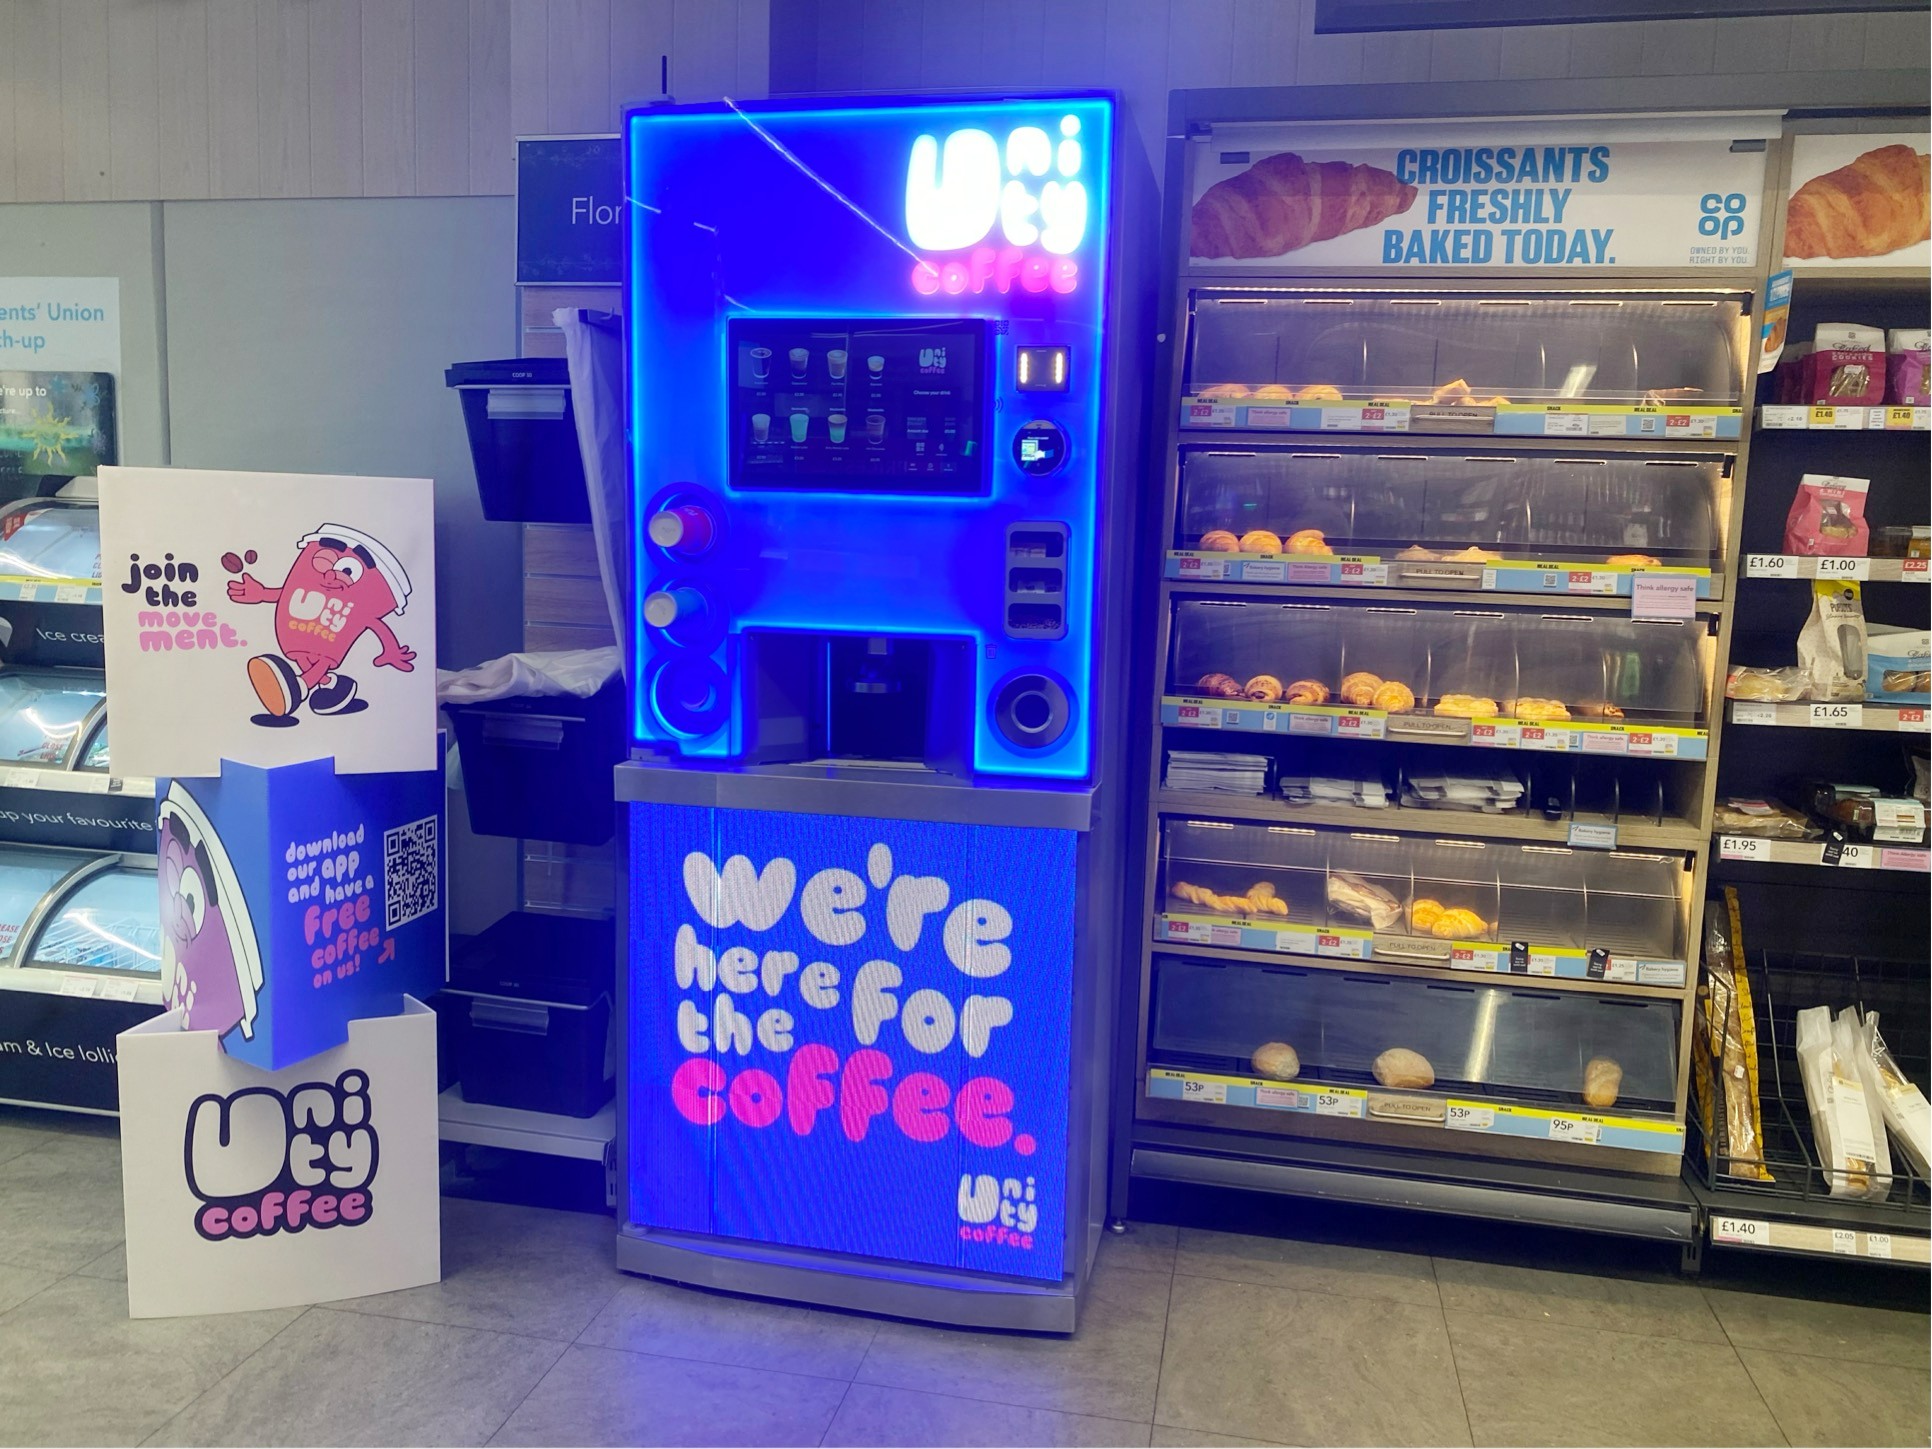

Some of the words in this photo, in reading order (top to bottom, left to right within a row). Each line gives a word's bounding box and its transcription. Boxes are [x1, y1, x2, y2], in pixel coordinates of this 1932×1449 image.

[1396, 145, 1610, 185] CROISSANTS
[1427, 188, 1572, 225] FRESHLY
[1382, 228, 1494, 264] BAKED
[1501, 228, 1616, 265] TODAY.
[1690, 246, 1717, 255] OWNED
[1719, 246, 1729, 255] BY
[1689, 255, 1716, 264] RIGHT
[1718, 255, 1729, 264] BY
[47, 302, 104, 321] Union
[0, 328, 46, 354] h-up
[18, 387, 33, 399] up
[35, 386, 47, 397] to
[1750, 557, 1784, 569] £1.60
[1820, 560, 1856, 571] £1.00
[1904, 561, 1927, 569] £2.25
[121, 553, 199, 593] join
[145, 584, 197, 607] the
[1655, 584, 1679, 593] allergy
[138, 611, 218, 628] move
[36, 627, 67, 641] Ice
[139, 622, 248, 652] ment.
[1814, 706, 1848, 718] £1.65
[22, 812, 64, 824] your
[66, 813, 153, 831] favourite
[285, 823, 365, 863] download
[1723, 839, 1757, 851] £1.95
[287, 861, 317, 882] our
[321, 851, 360, 883] app
[288, 875, 320, 904] and
[325, 879, 363, 905] have
[365, 874, 375, 890] a
[311, 927, 380, 969] coffee
[313, 970, 333, 989] on
[336, 952, 361, 980] us!
[674, 923, 841, 1010] here
[677, 992, 794, 1056] the
[26, 1039, 43, 1056] &
[45, 1041, 75, 1060] Ice
[78, 1044, 118, 1064] lolli
[1184, 1081, 1205, 1092] 53P
[1318, 1095, 1339, 1106] 53P
[1450, 1107, 1471, 1118] 53P
[1553, 1119, 1574, 1131] 95P
[199, 1189, 368, 1237] coffee
[1721, 1221, 1756, 1235] £1.40
[1834, 1232, 1854, 1241] £2.05
[1869, 1235, 1889, 1244] £1.00
